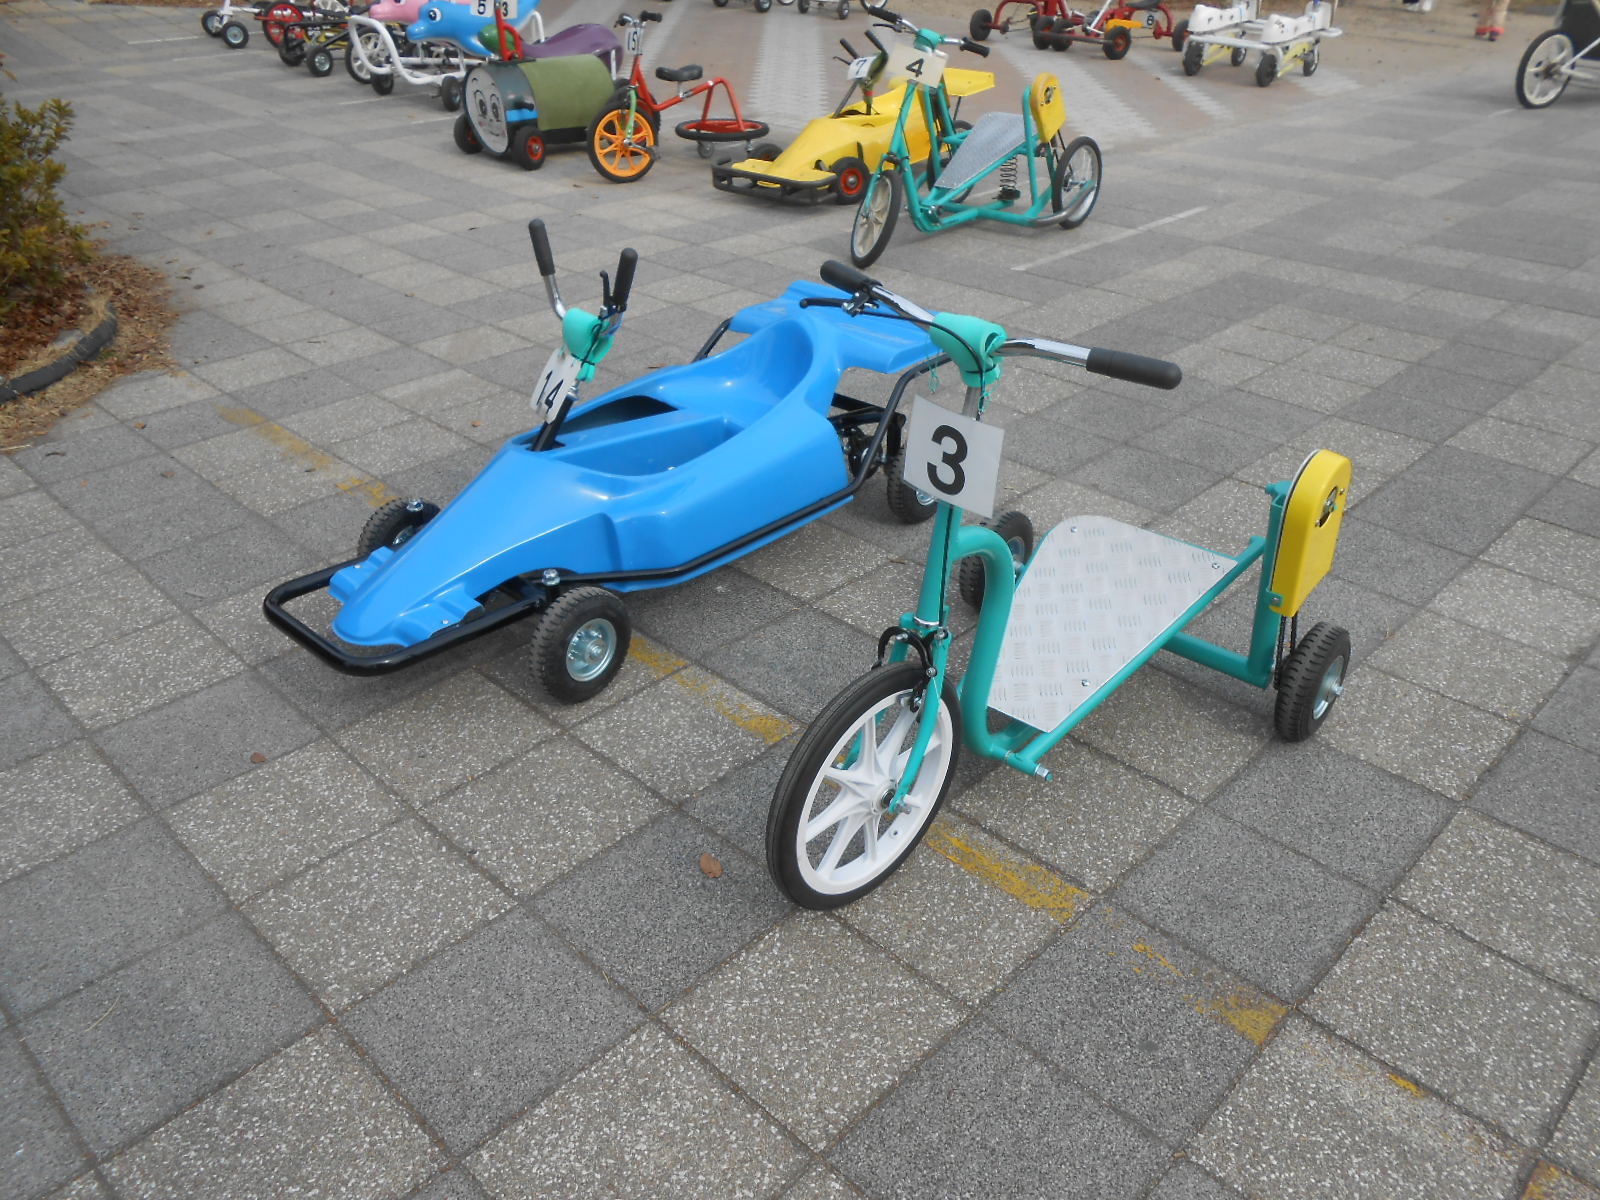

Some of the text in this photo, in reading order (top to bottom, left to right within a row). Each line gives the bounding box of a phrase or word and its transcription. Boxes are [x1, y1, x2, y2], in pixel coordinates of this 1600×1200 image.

[477, 0, 486, 15] 5
[855, 59, 868, 75] 7
[905, 58, 924, 78] 4
[536, 370, 564, 415] 14
[926, 424, 968, 496] 3
